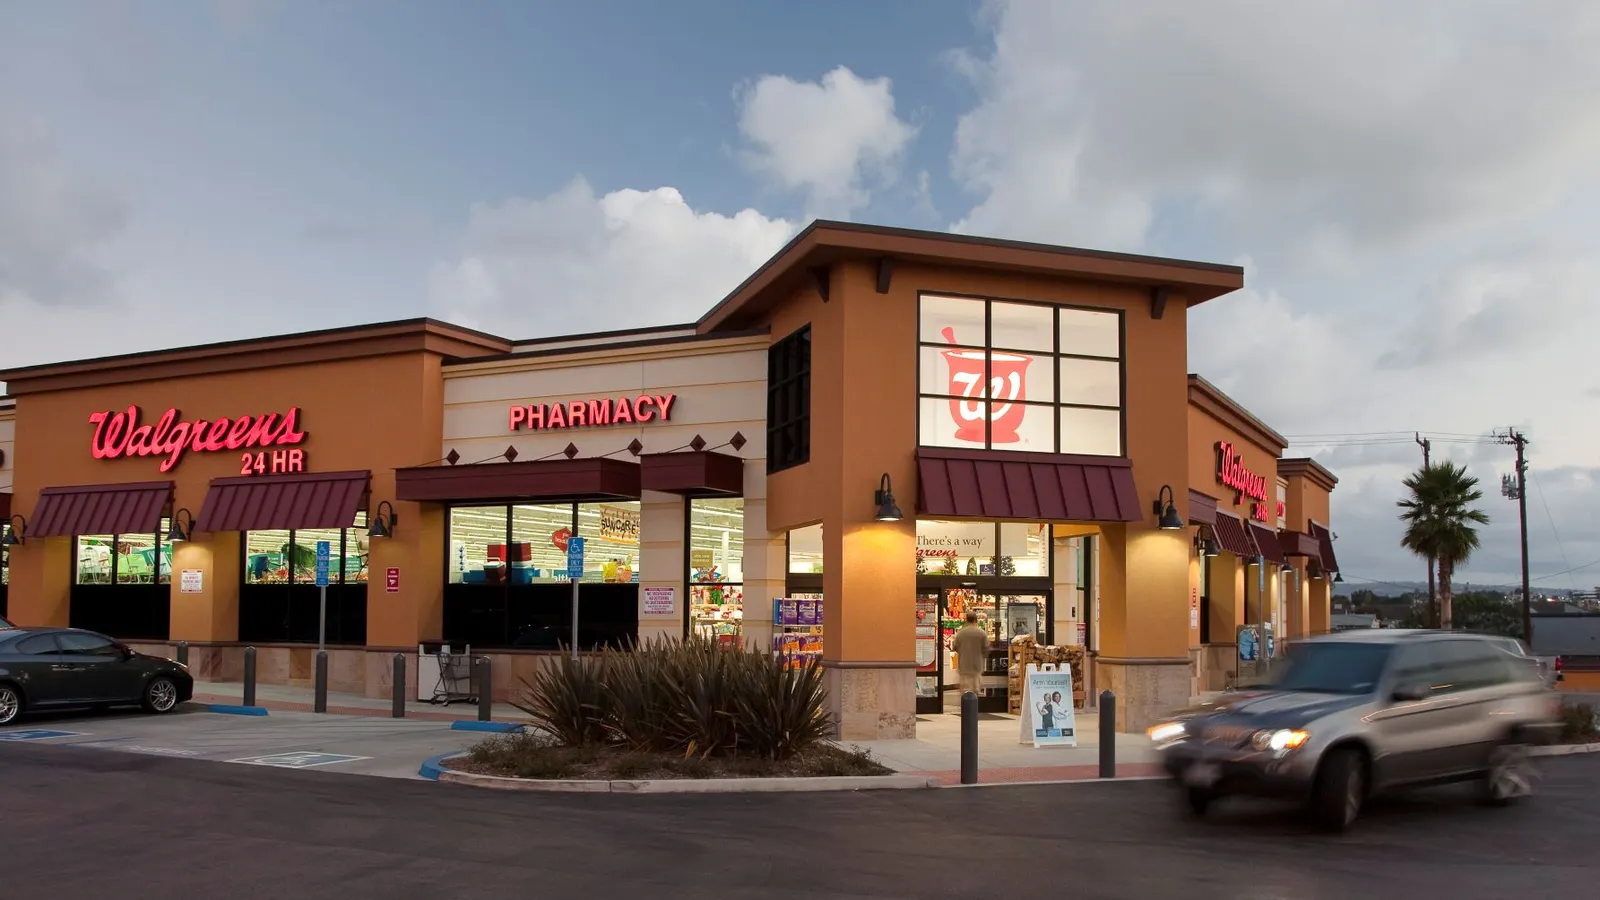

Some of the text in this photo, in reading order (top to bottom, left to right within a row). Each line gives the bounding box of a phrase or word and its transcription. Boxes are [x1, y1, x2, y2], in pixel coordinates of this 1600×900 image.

[509, 393, 677, 430] PHARMACY
[88, 404, 309, 473] Walgreens
[240, 447, 308, 476] 24 HR
[1219, 441, 1268, 504] Walgreens
[916, 535, 984, 549] There's a way
